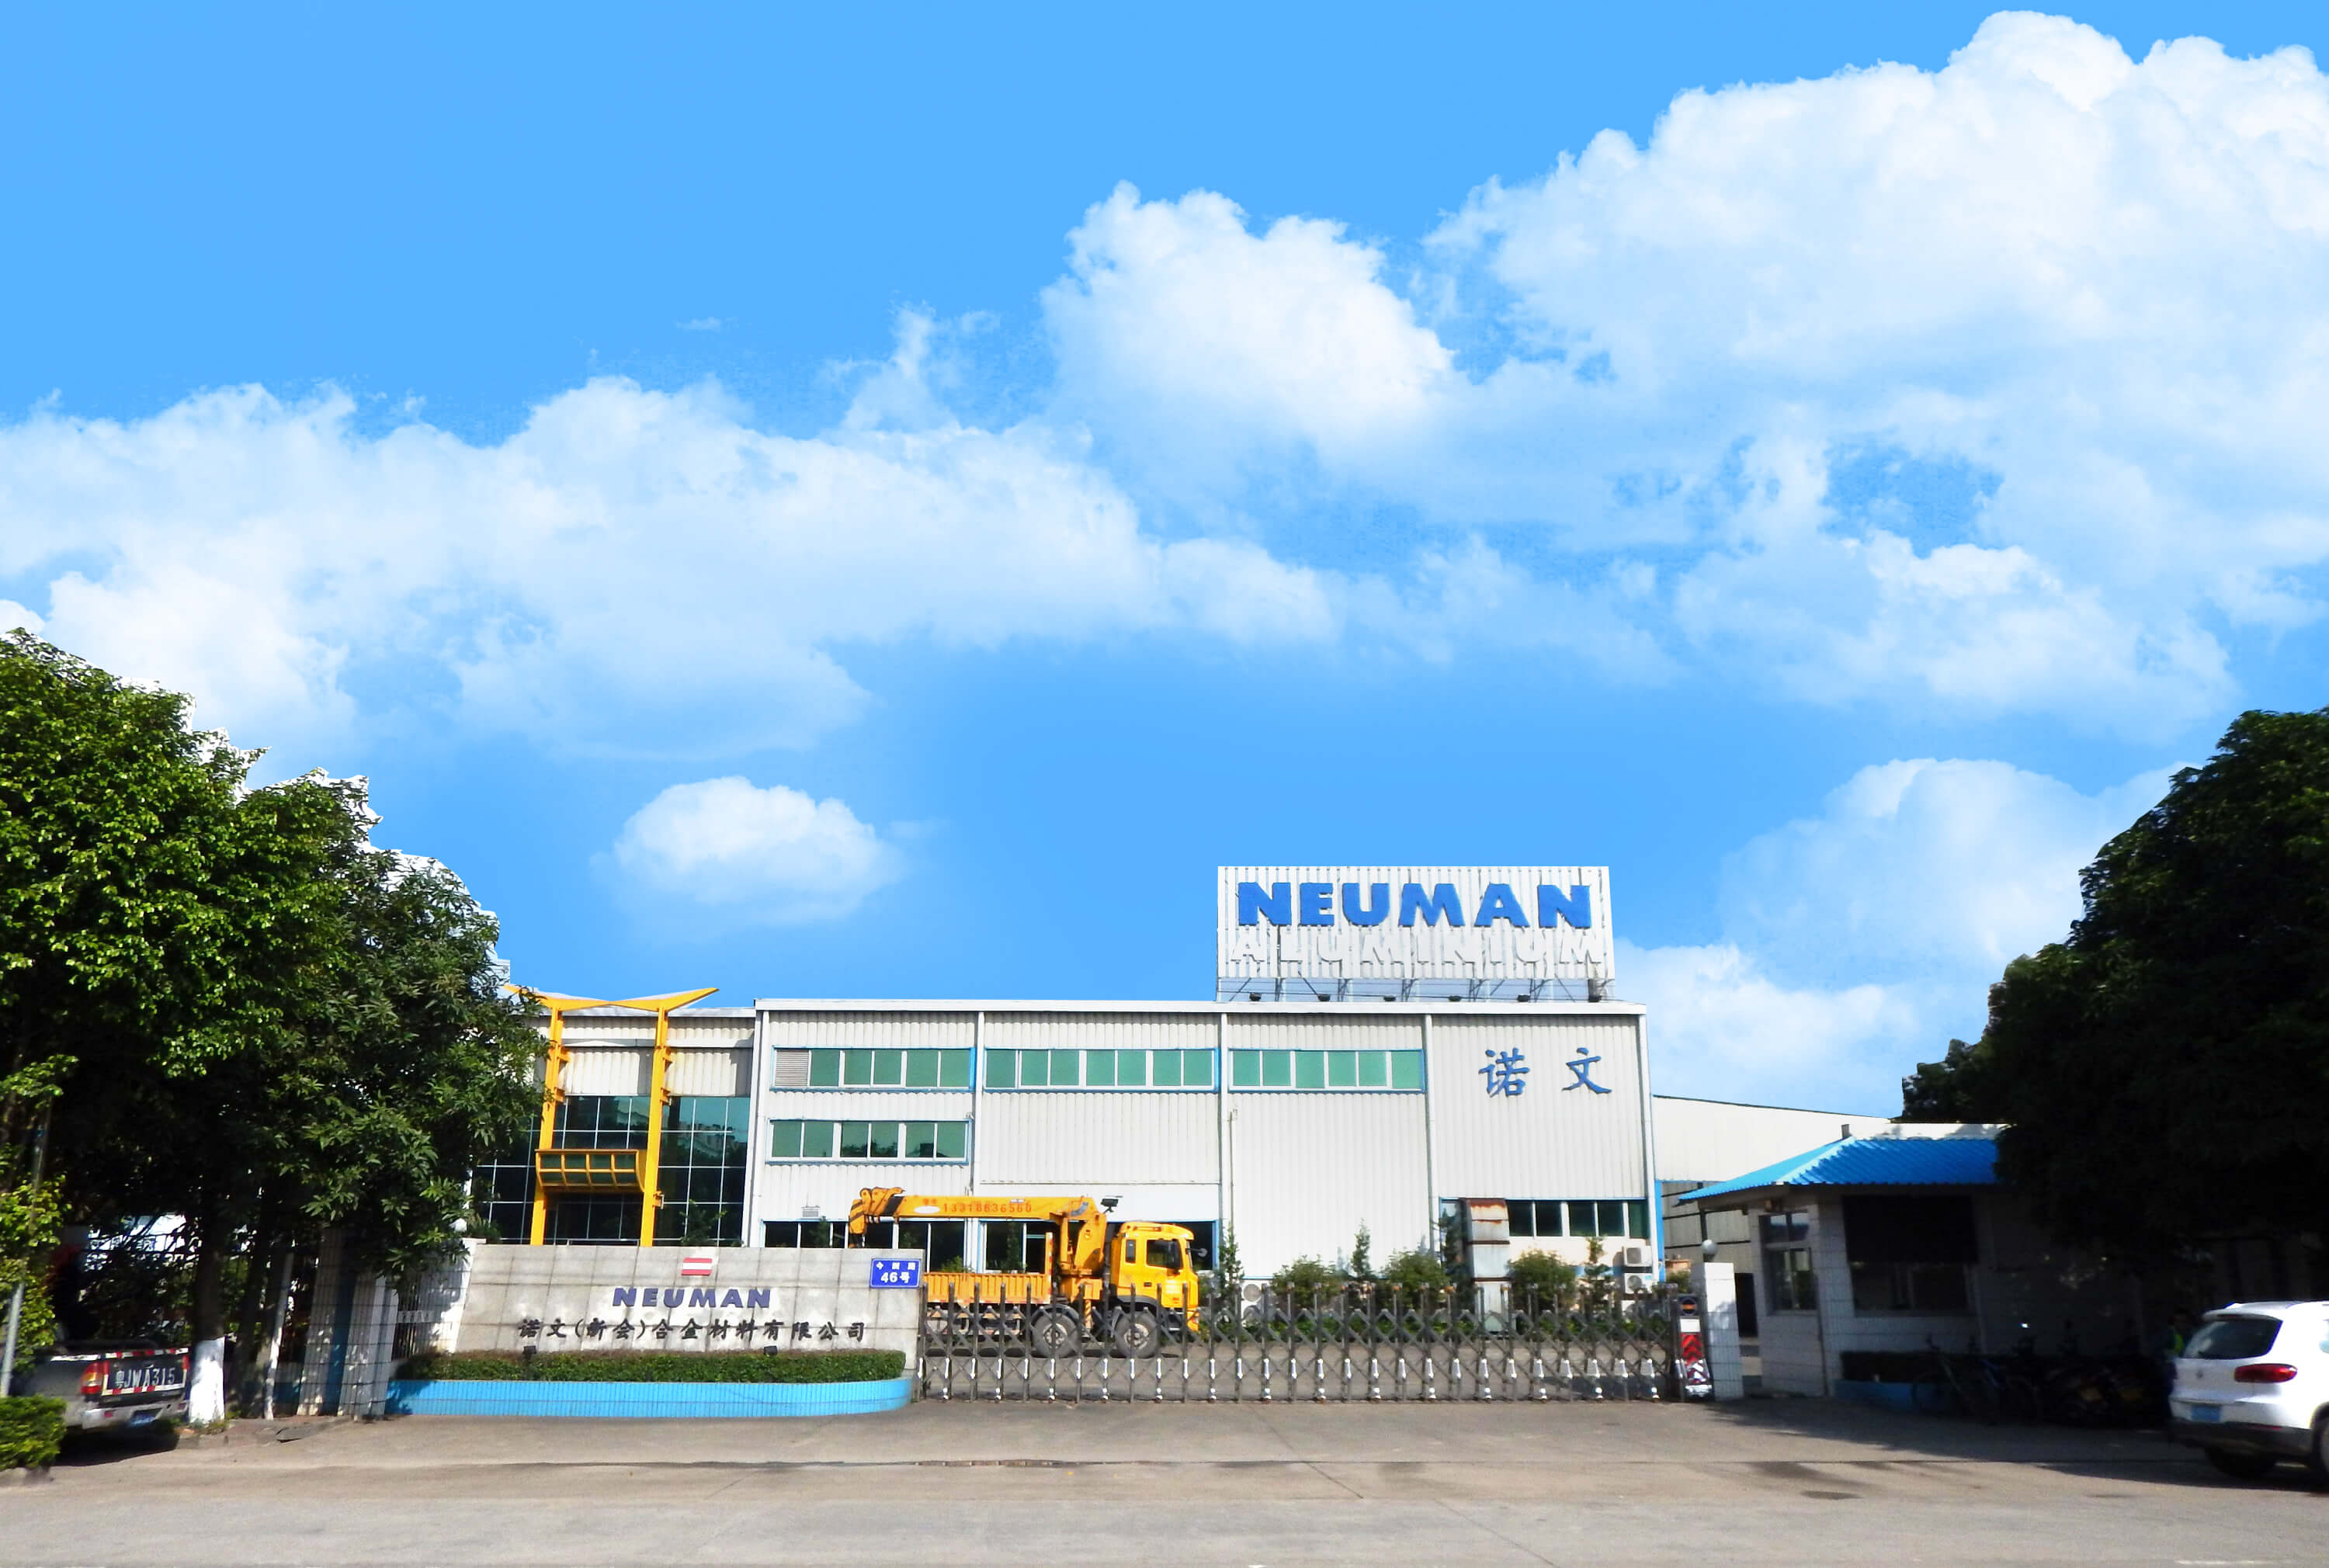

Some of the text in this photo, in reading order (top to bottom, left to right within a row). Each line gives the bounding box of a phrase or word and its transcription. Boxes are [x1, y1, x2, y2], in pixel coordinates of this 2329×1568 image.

[1237, 882, 1592, 928] NEUMAN
[1230, 933, 1603, 964] ALUMINIUM
[1478, 1046, 1612, 1098] 诺文
[880, 1271, 911, 1284] 46号
[612, 1287, 772, 1309] NEUMAN
